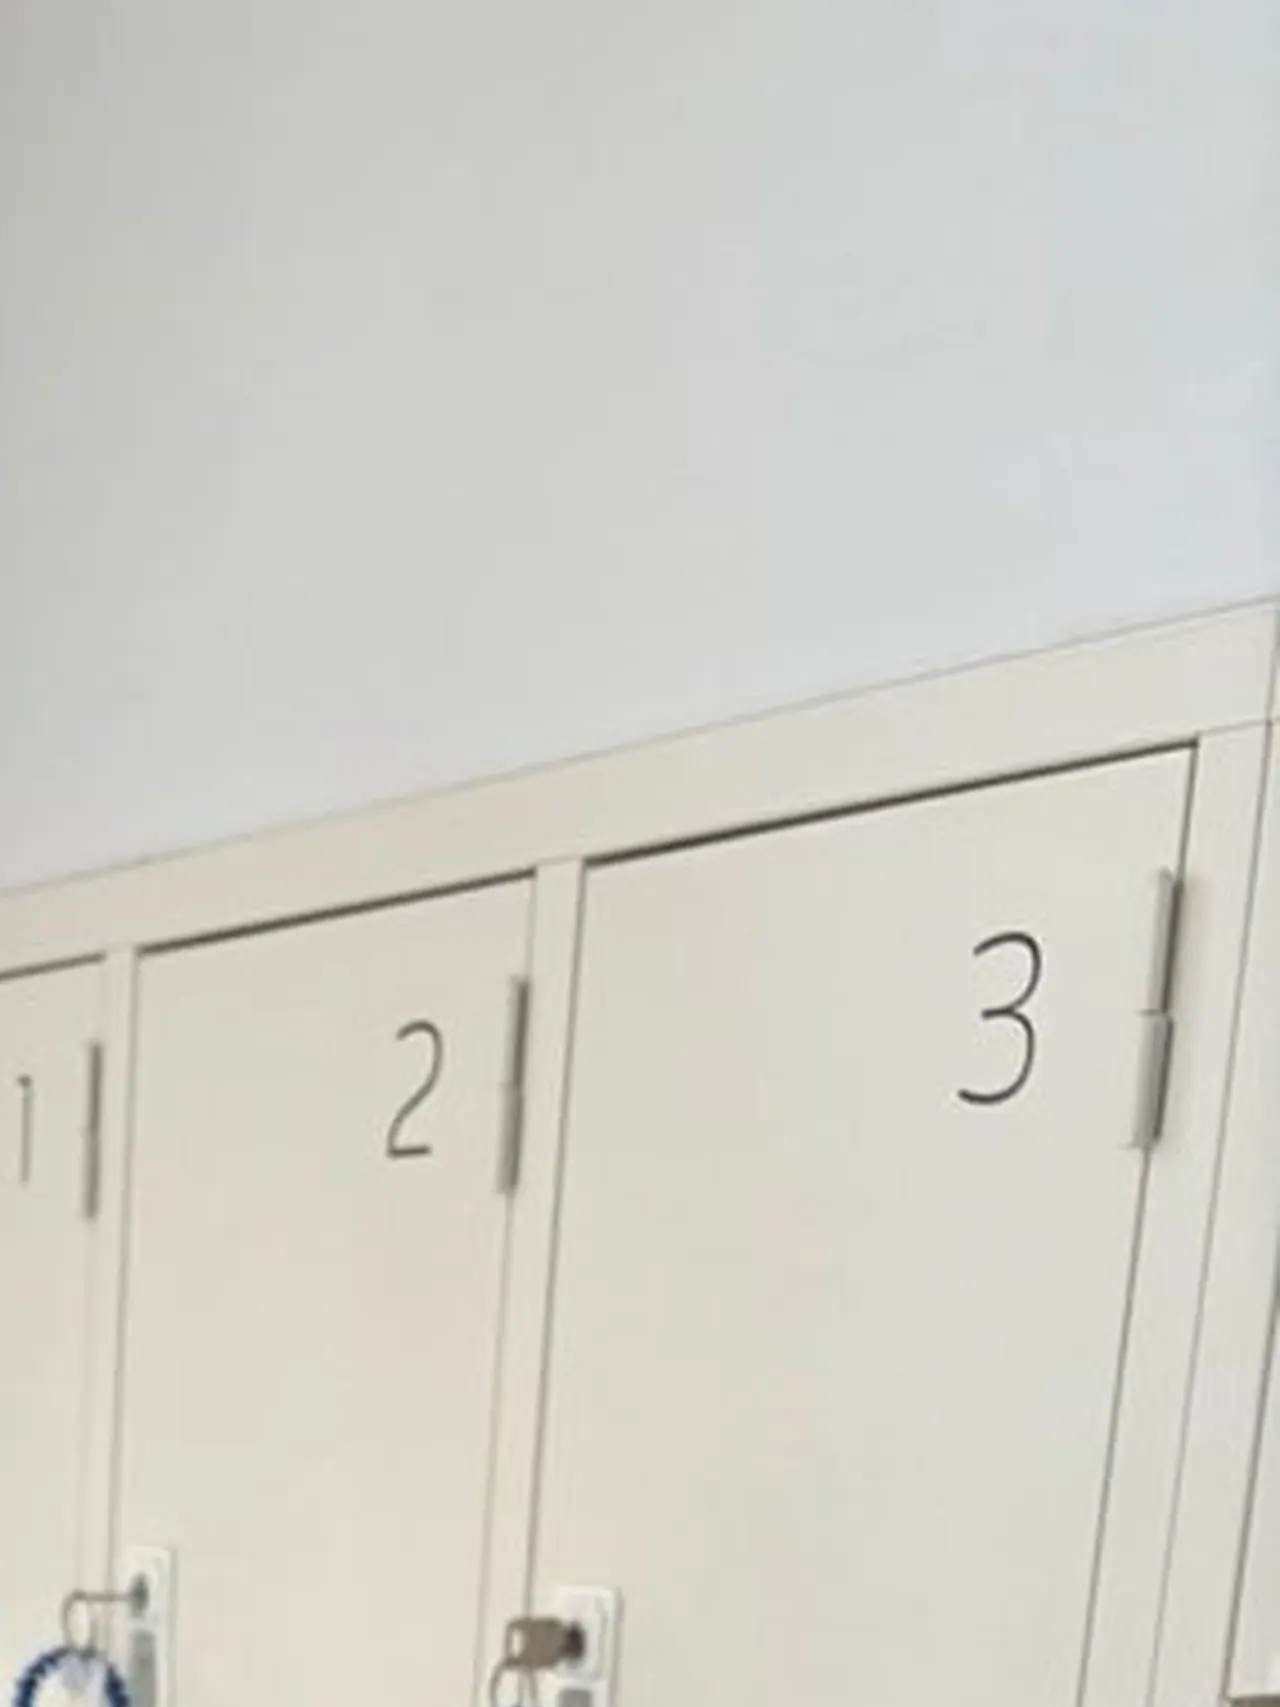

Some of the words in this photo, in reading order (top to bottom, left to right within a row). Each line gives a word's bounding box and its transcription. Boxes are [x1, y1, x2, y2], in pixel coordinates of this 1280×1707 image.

[386, 1018, 444, 1160] 2
[958, 930, 1042, 1106] 3
[16, 1073, 36, 1187] 1
